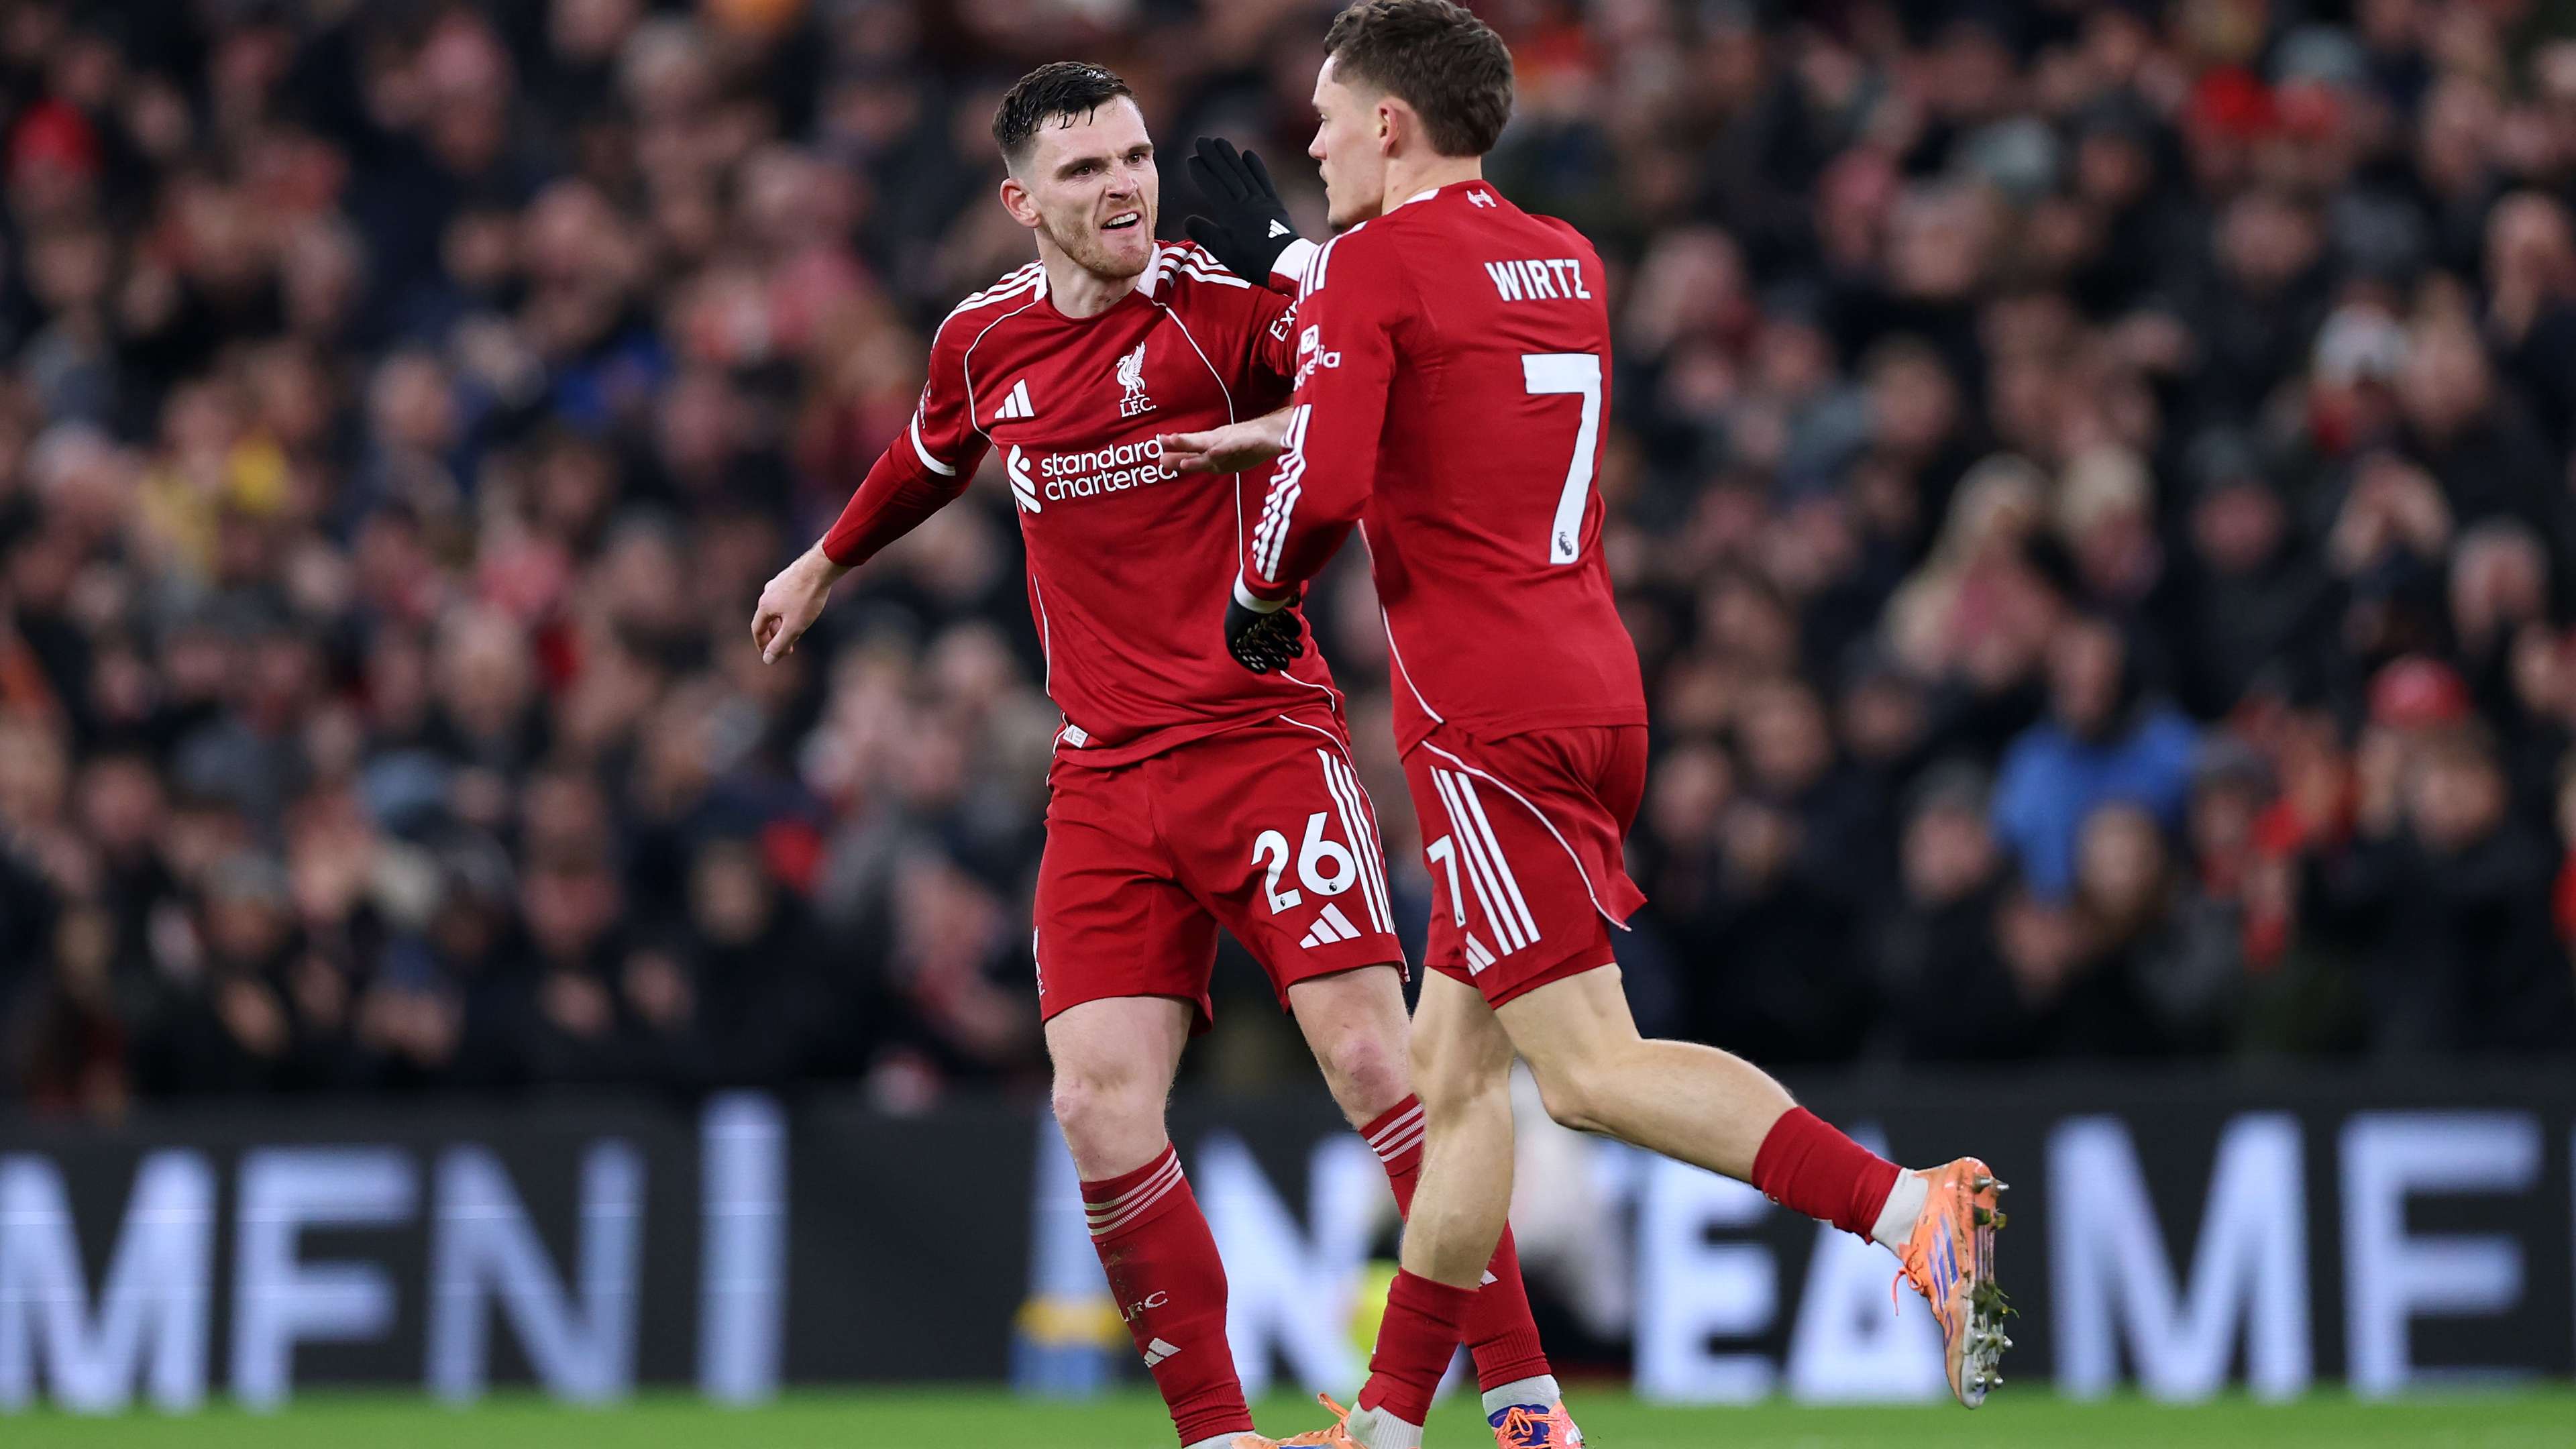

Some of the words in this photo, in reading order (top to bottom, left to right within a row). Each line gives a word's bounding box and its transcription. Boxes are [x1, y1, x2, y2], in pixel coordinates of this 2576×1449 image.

[1484, 259, 1592, 301] WIRTZ
[1041, 433, 1164, 478] standard
[1521, 352, 1602, 565] 7
[1250, 812, 1356, 915] 26
[1426, 835, 1468, 928] 7
